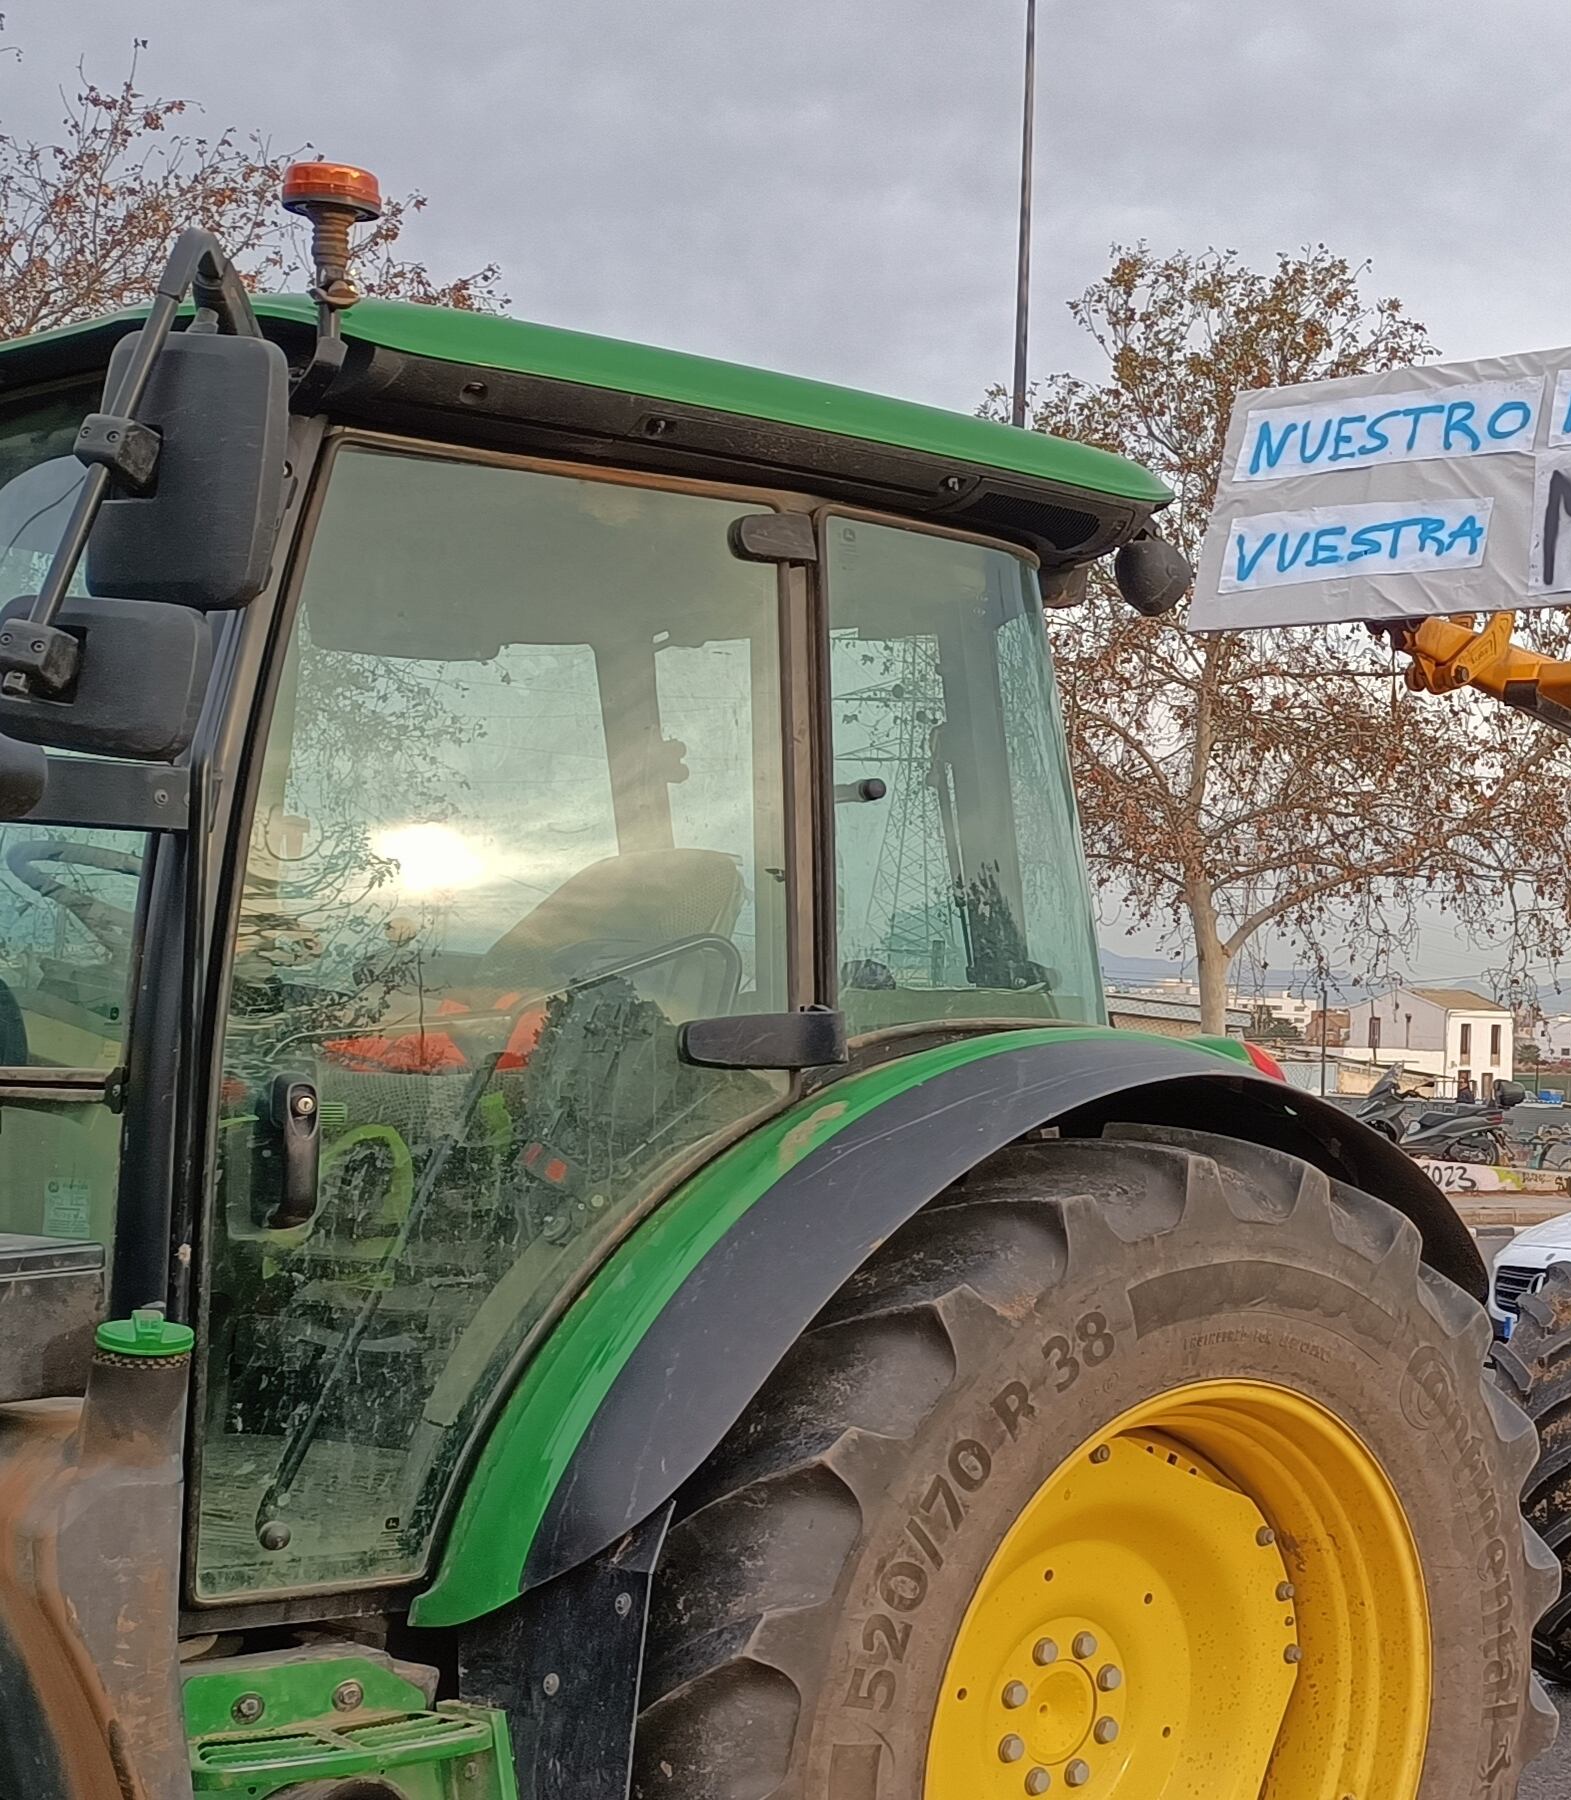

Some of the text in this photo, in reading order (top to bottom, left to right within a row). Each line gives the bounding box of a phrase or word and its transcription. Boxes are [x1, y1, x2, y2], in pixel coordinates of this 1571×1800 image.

[1235, 515, 1484, 582] VUESTRA
[1249, 400, 1531, 476] NUESTRO
[842, 1311, 1116, 1712] 520/70 R 38
[1400, 1346, 1520, 1724] Continental
